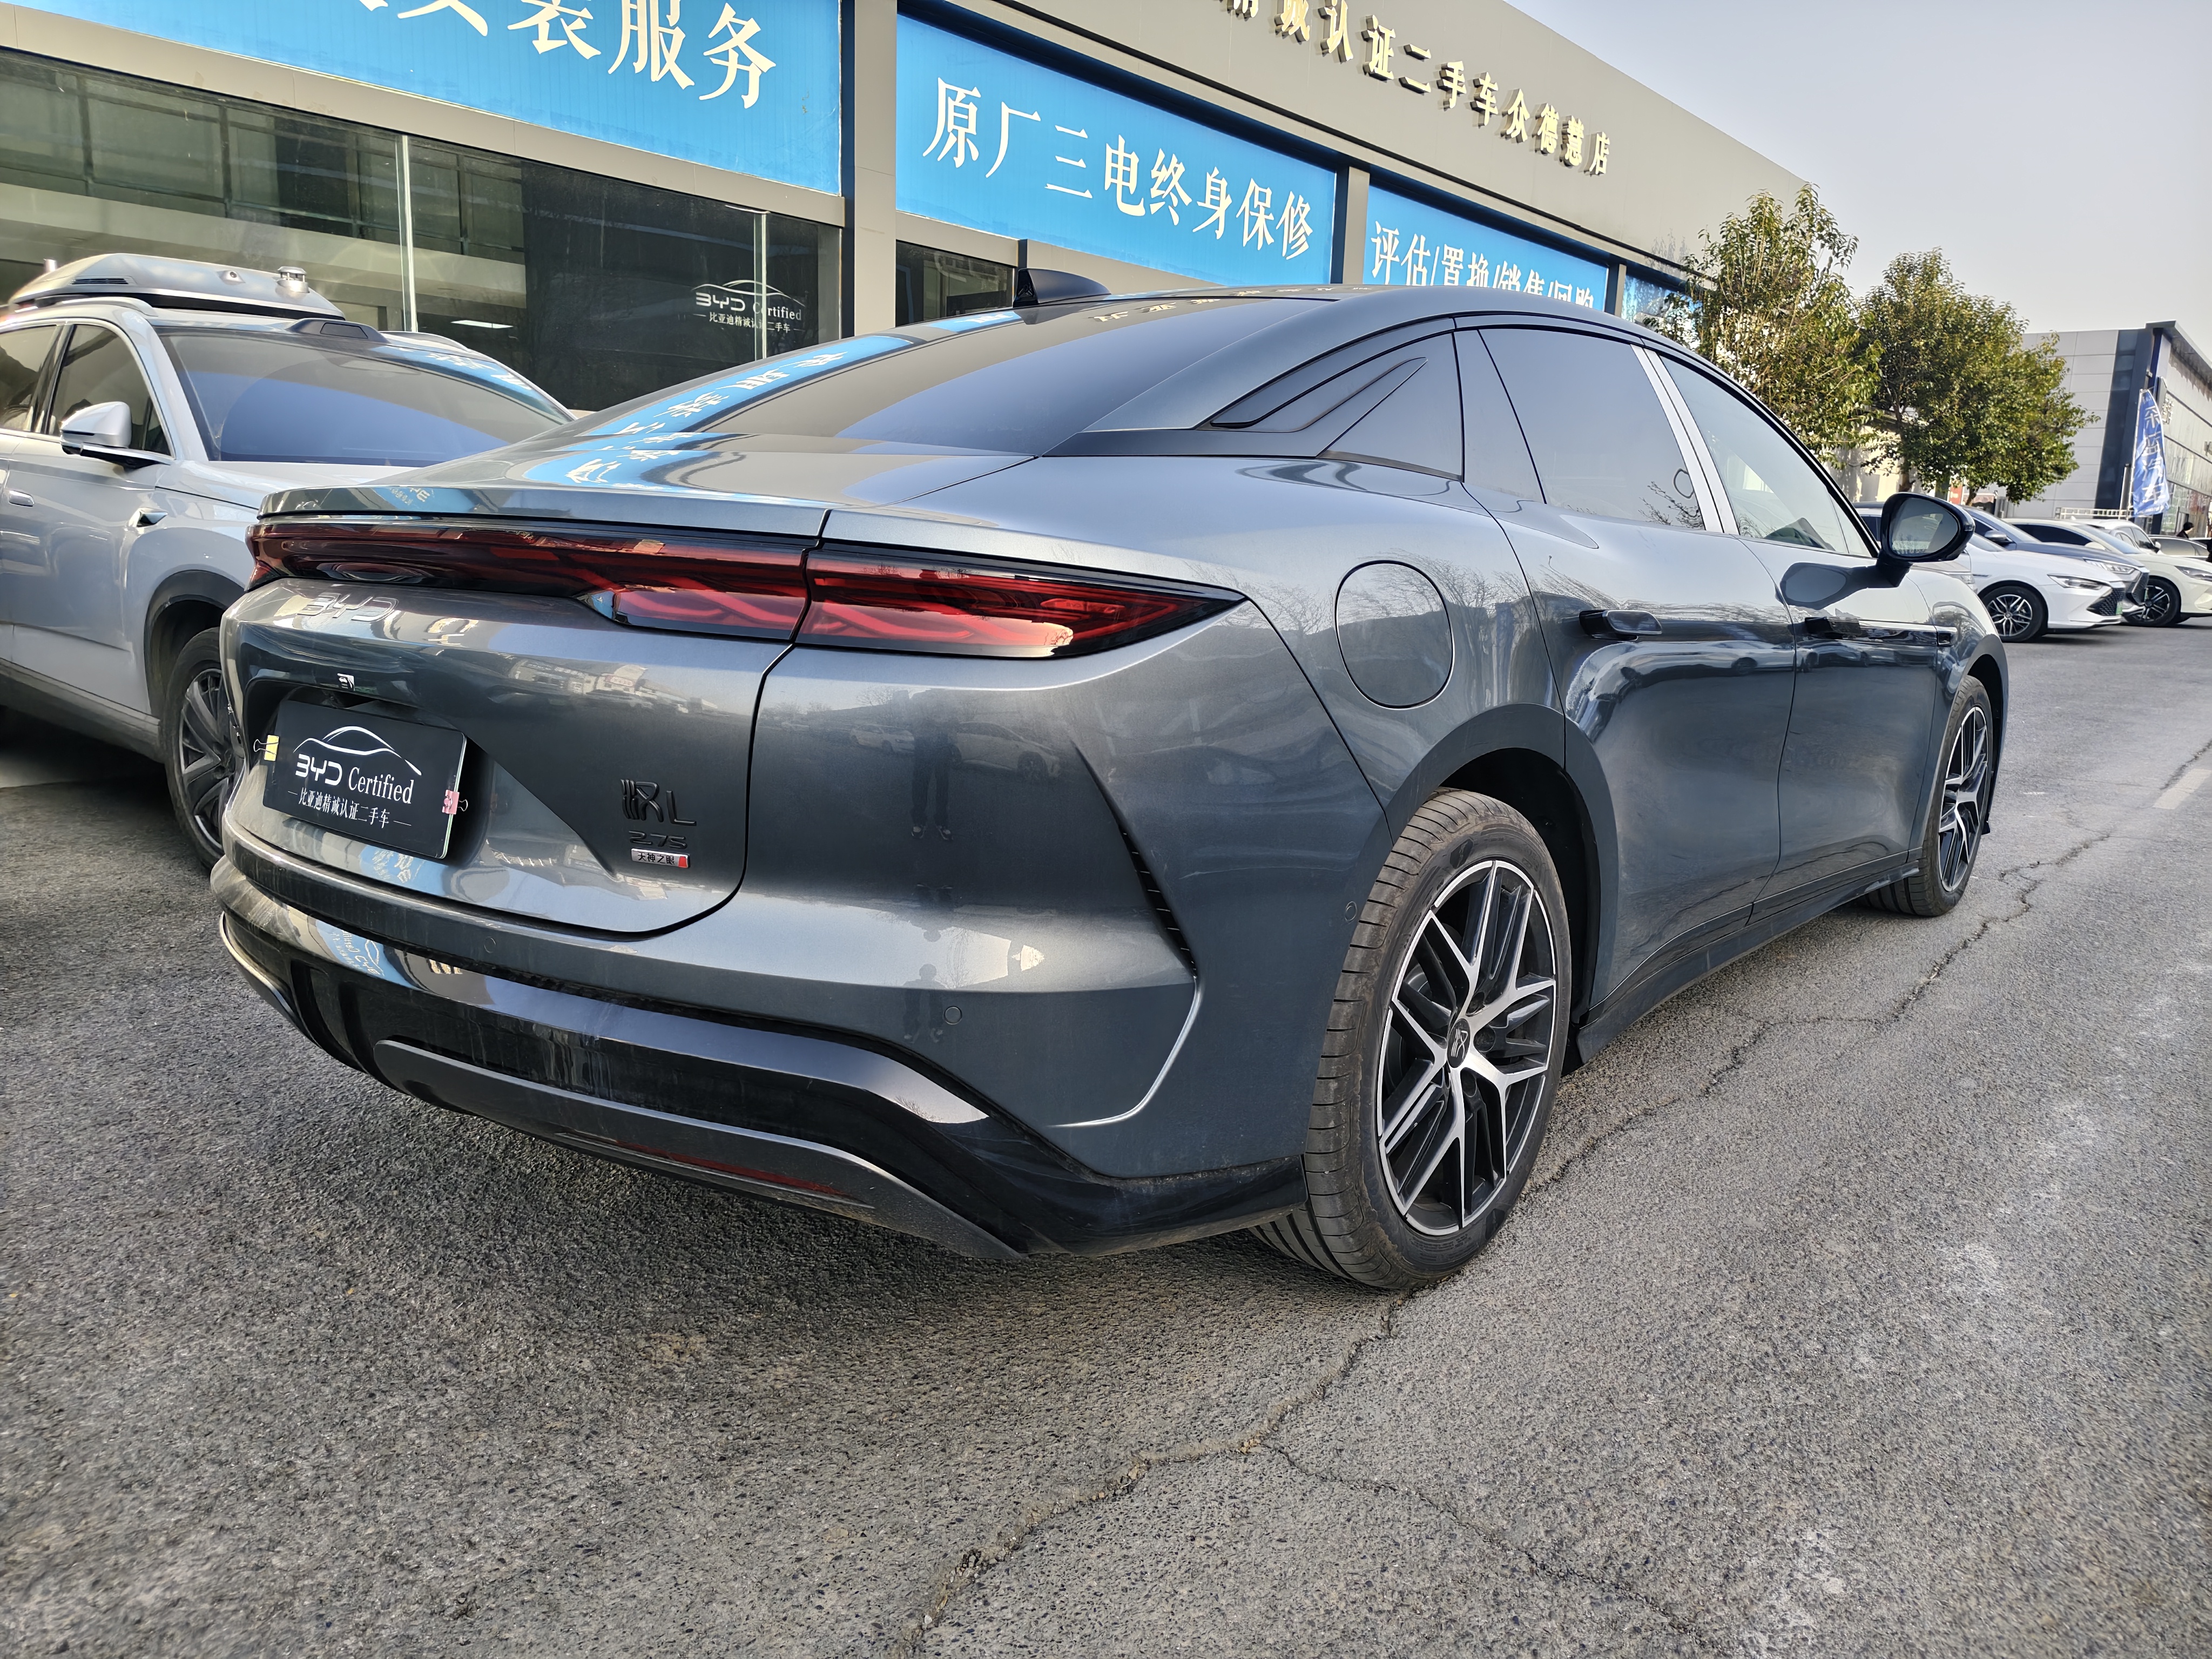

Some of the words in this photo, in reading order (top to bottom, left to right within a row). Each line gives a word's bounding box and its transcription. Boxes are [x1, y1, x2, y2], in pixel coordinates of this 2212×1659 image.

[1228, 0, 1610, 176] 诚认证二手车众德慧店
[922, 77, 1314, 261] 原厂三电终身保修
[696, 292, 746, 312] BYD
[296, 592, 399, 622] BYD
[295, 753, 342, 786] BYD
[348, 766, 414, 804] Certified
[298, 787, 390, 829] 比亚迪精诚认证二手车
[637, 852, 675, 865] 天神之眼
